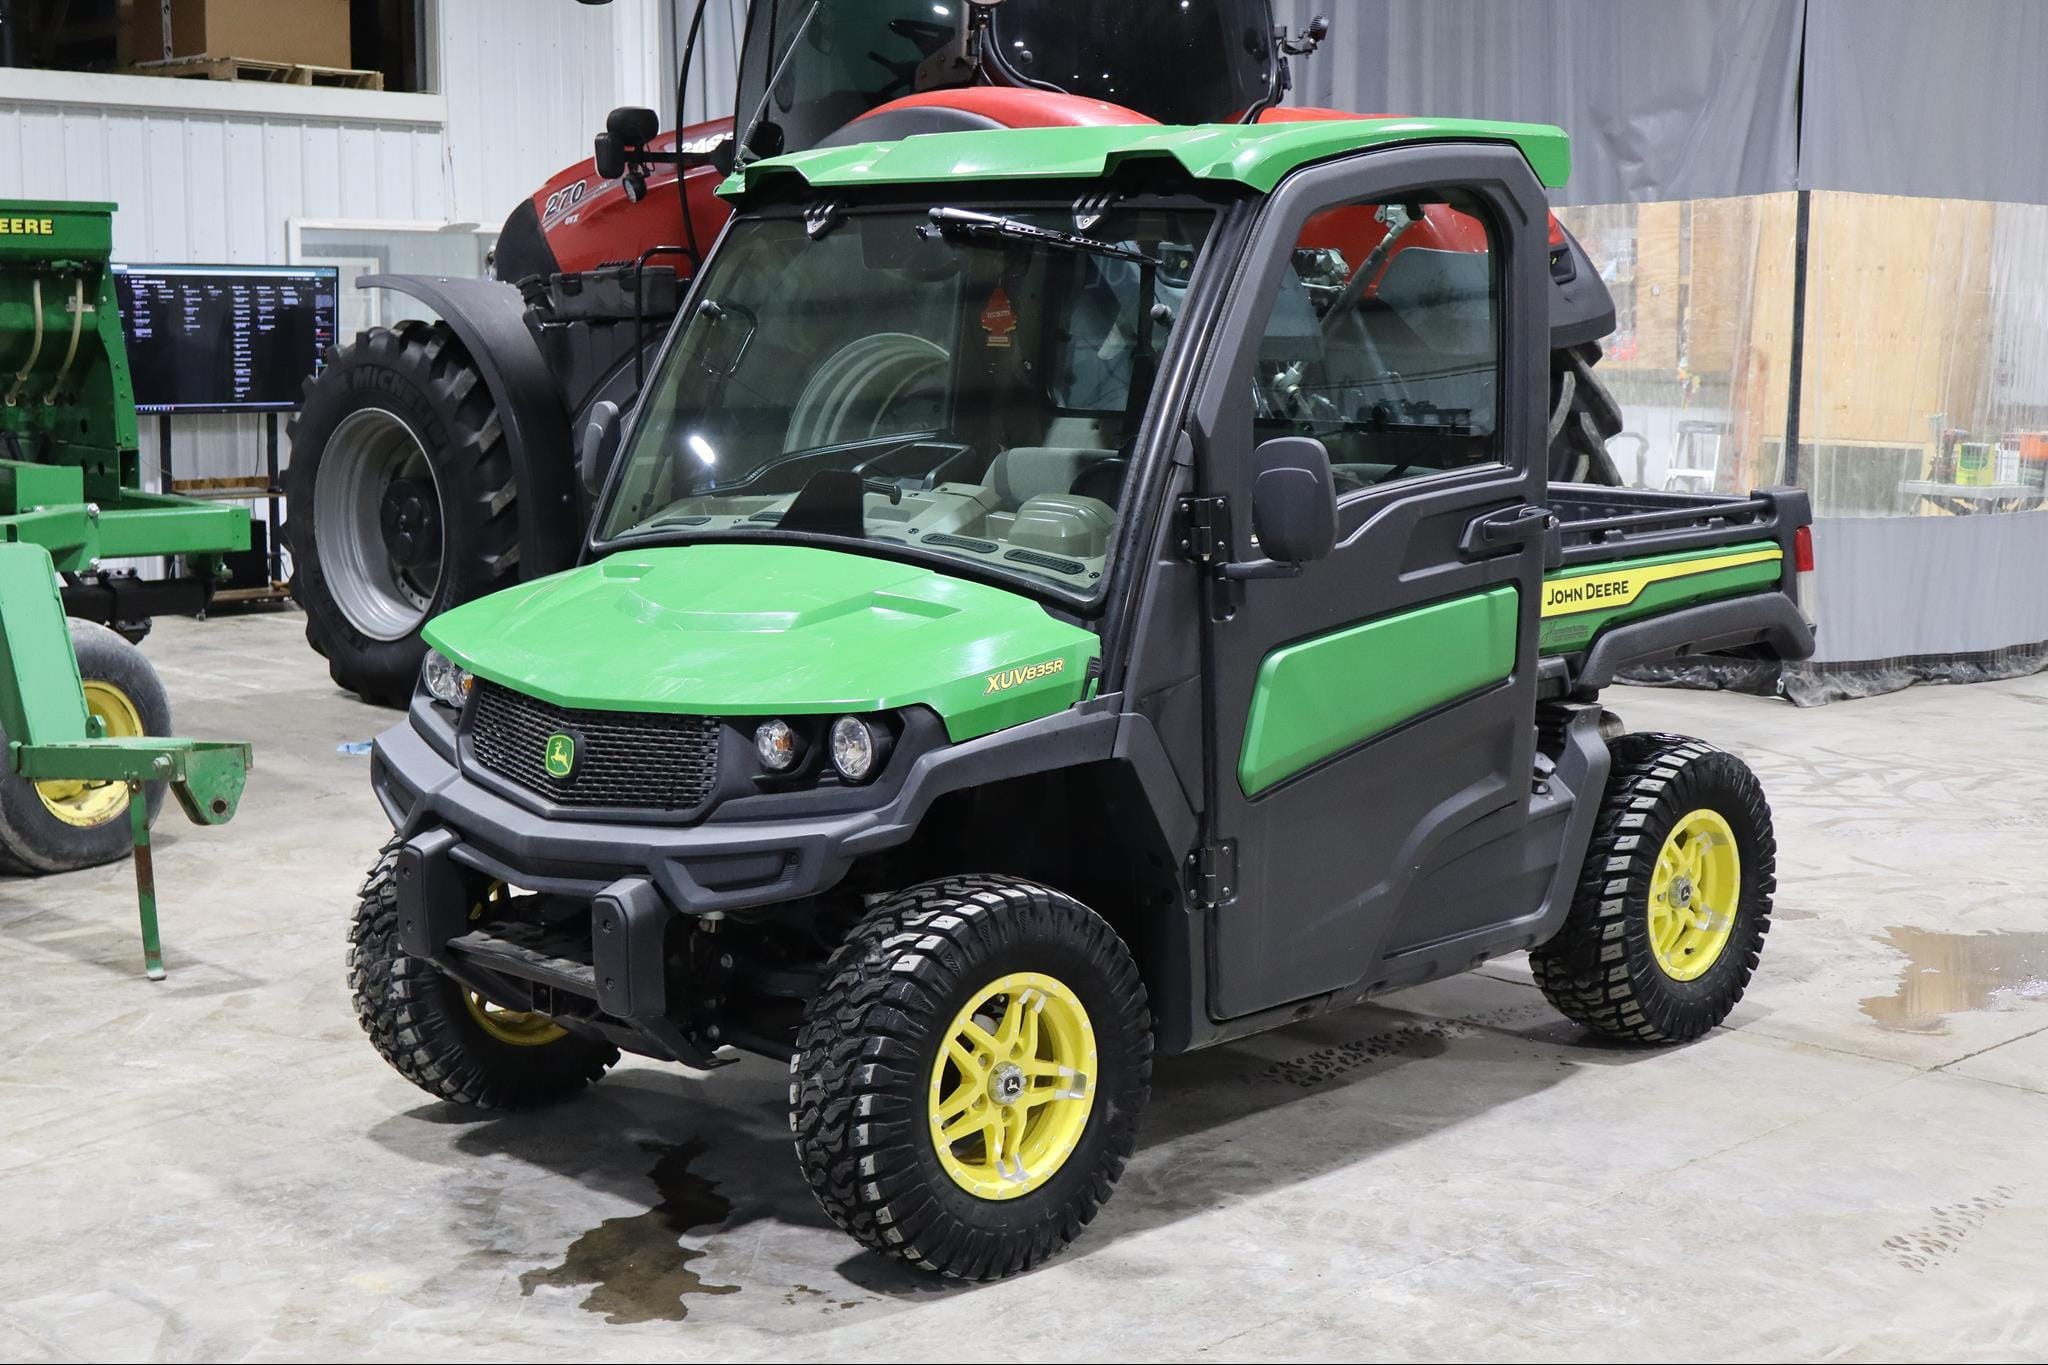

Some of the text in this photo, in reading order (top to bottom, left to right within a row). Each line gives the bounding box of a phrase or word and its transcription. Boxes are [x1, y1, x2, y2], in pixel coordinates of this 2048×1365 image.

[543, 180, 586, 219] 270
[0, 218, 53, 234] EERE
[984, 658, 1064, 695] XUV835R
